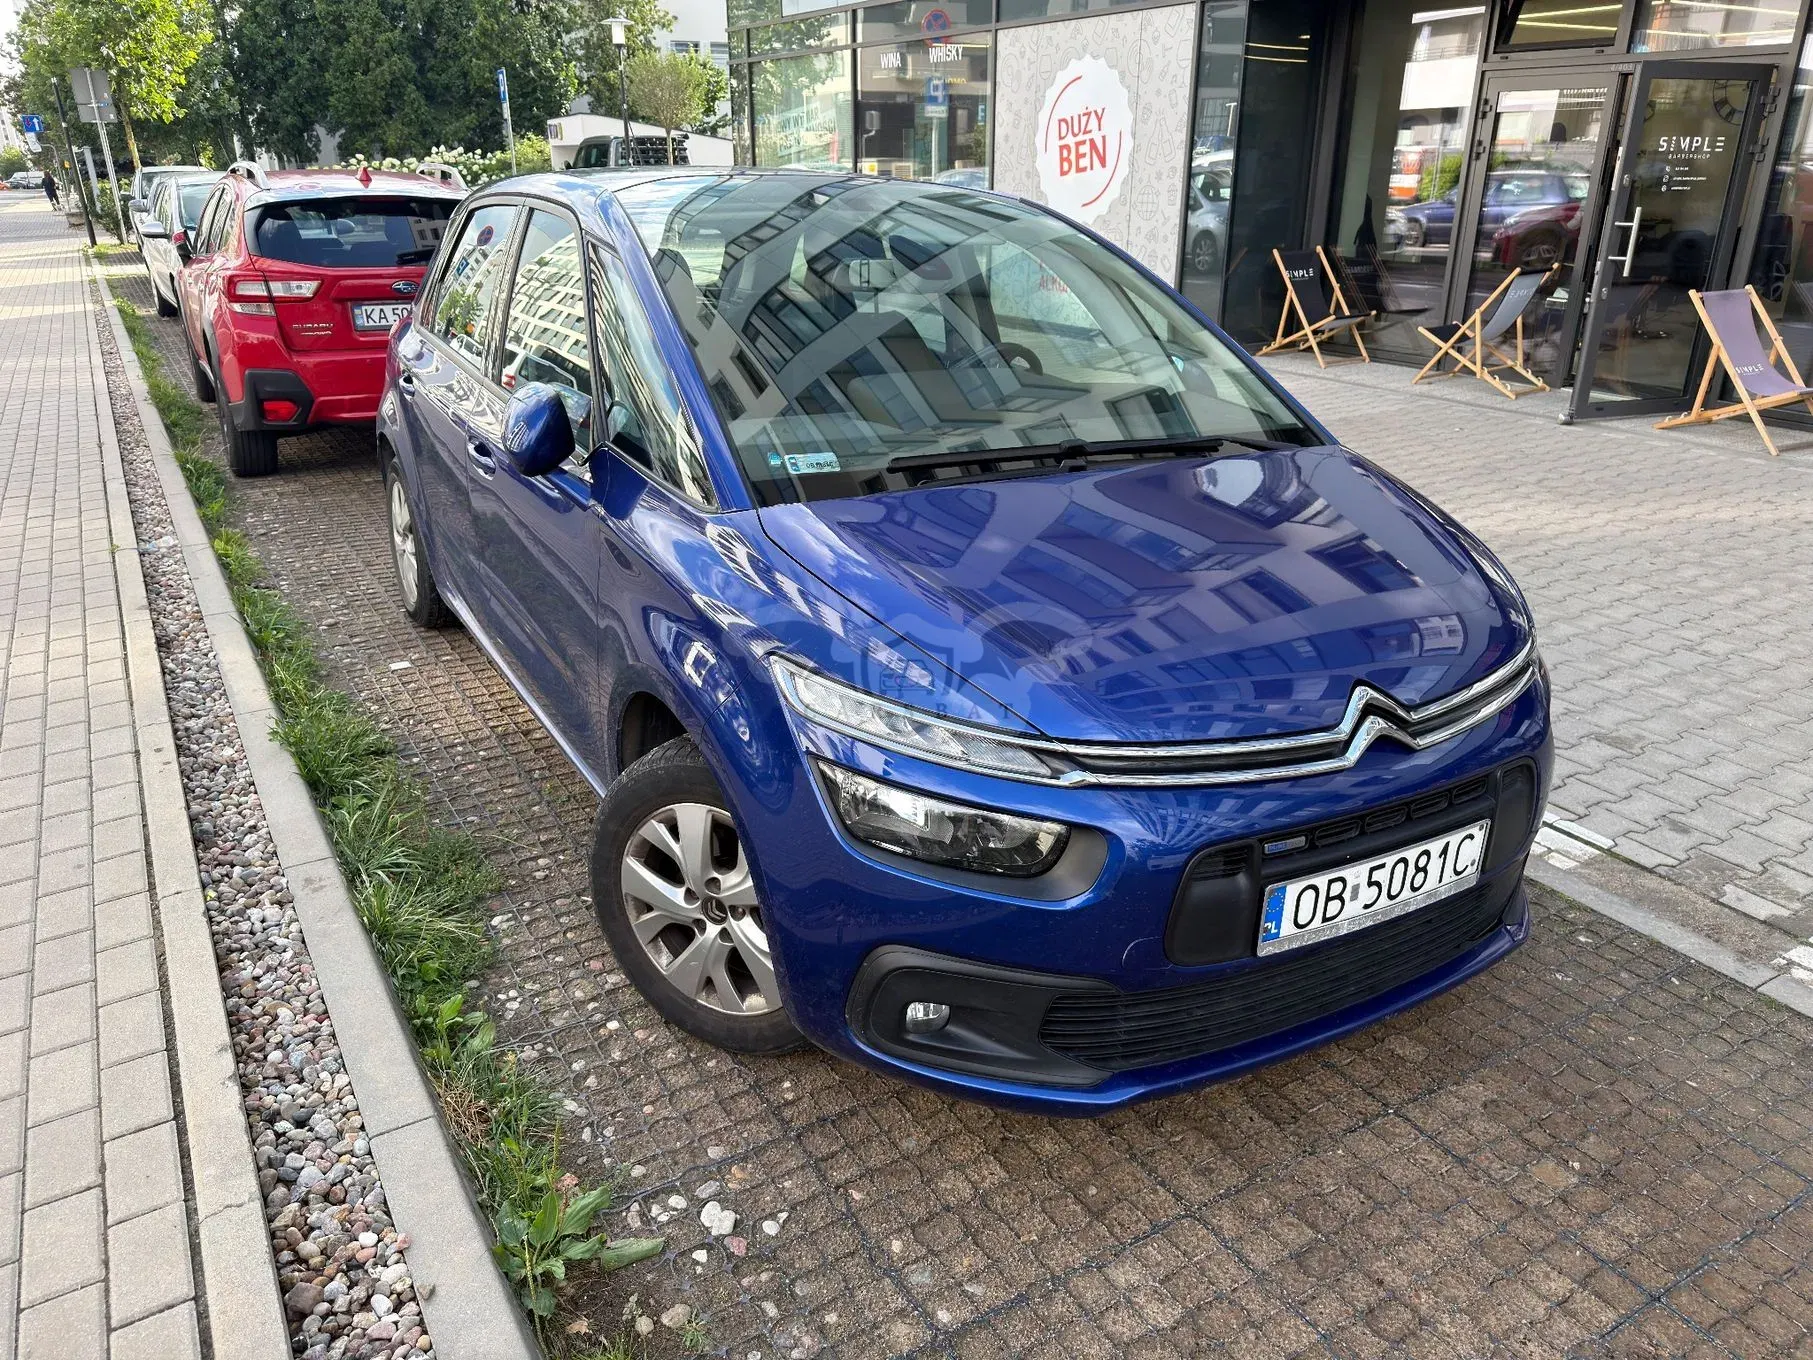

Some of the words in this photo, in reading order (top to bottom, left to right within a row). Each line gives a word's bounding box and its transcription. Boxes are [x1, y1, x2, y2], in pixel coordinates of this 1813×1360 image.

[880, 52, 902, 69] WINA
[929, 45, 963, 63] WHISKY
[1057, 106, 1105, 141] DUŻY
[1658, 136, 1726, 152] SIMPLE
[1058, 135, 1107, 177] BEN
[1285, 268, 1314, 278] SIMPLE
[365, 307, 389, 324] KA
[1735, 363, 1764, 374] SIMPLE
[1292, 876, 1347, 930] OB
[1362, 833, 1475, 910] 5081C
